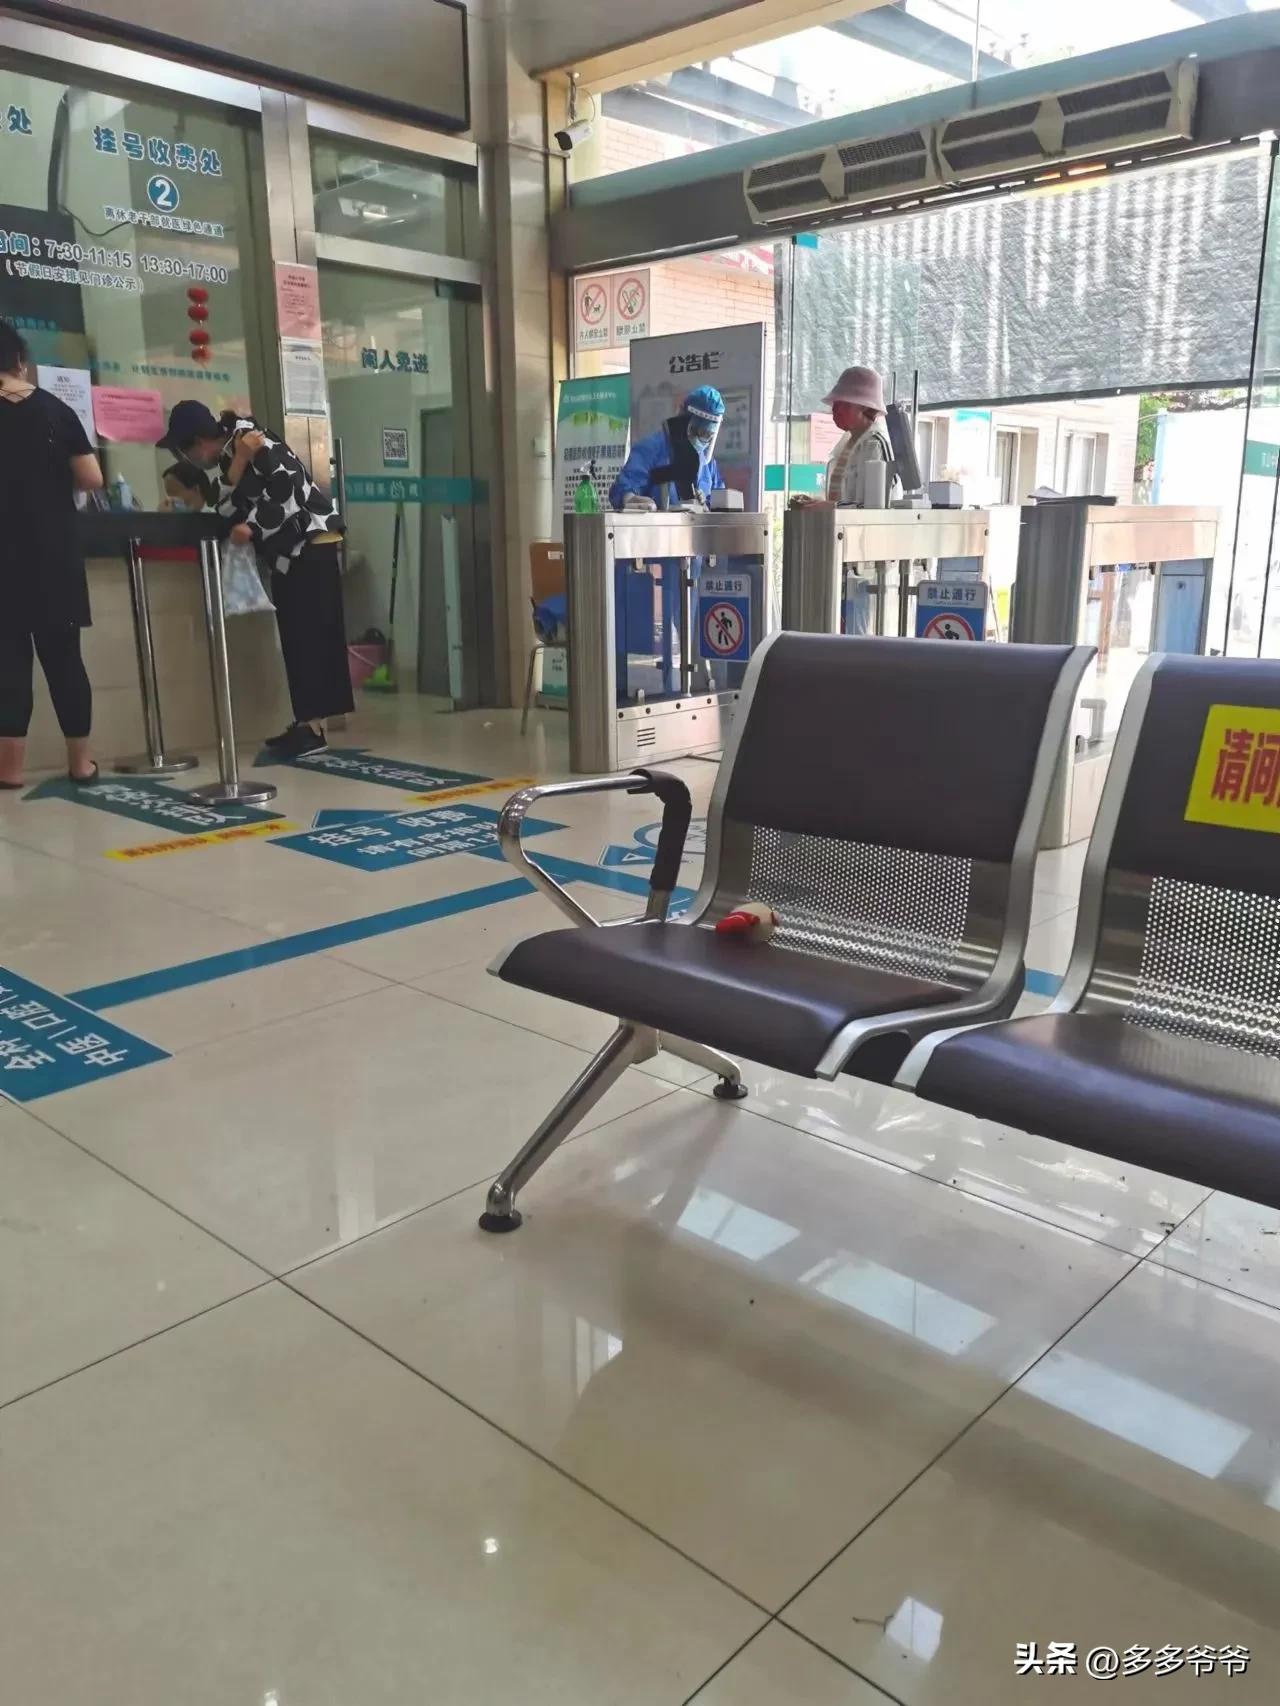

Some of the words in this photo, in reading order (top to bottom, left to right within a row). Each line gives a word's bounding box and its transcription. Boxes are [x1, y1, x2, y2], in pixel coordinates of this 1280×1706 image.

[0, 104, 33, 135] 处
[93, 125, 222, 176] 挂号收费处
[153, 177, 174, 208] 2
[103, 206, 224, 238] 离休老干部就医绿色通道
[138, 255, 229, 284] 13:30-17:00
[668, 352, 721, 374] 公告栏
[705, 580, 743, 592] 禁止通行
[927, 587, 977, 602] 禁止通行
[1211, 727, 1280, 809] 请间
[308, 825, 391, 847] 挂号
[396, 809, 477, 829] 收费
[356, 821, 498, 856] 请有序排队
